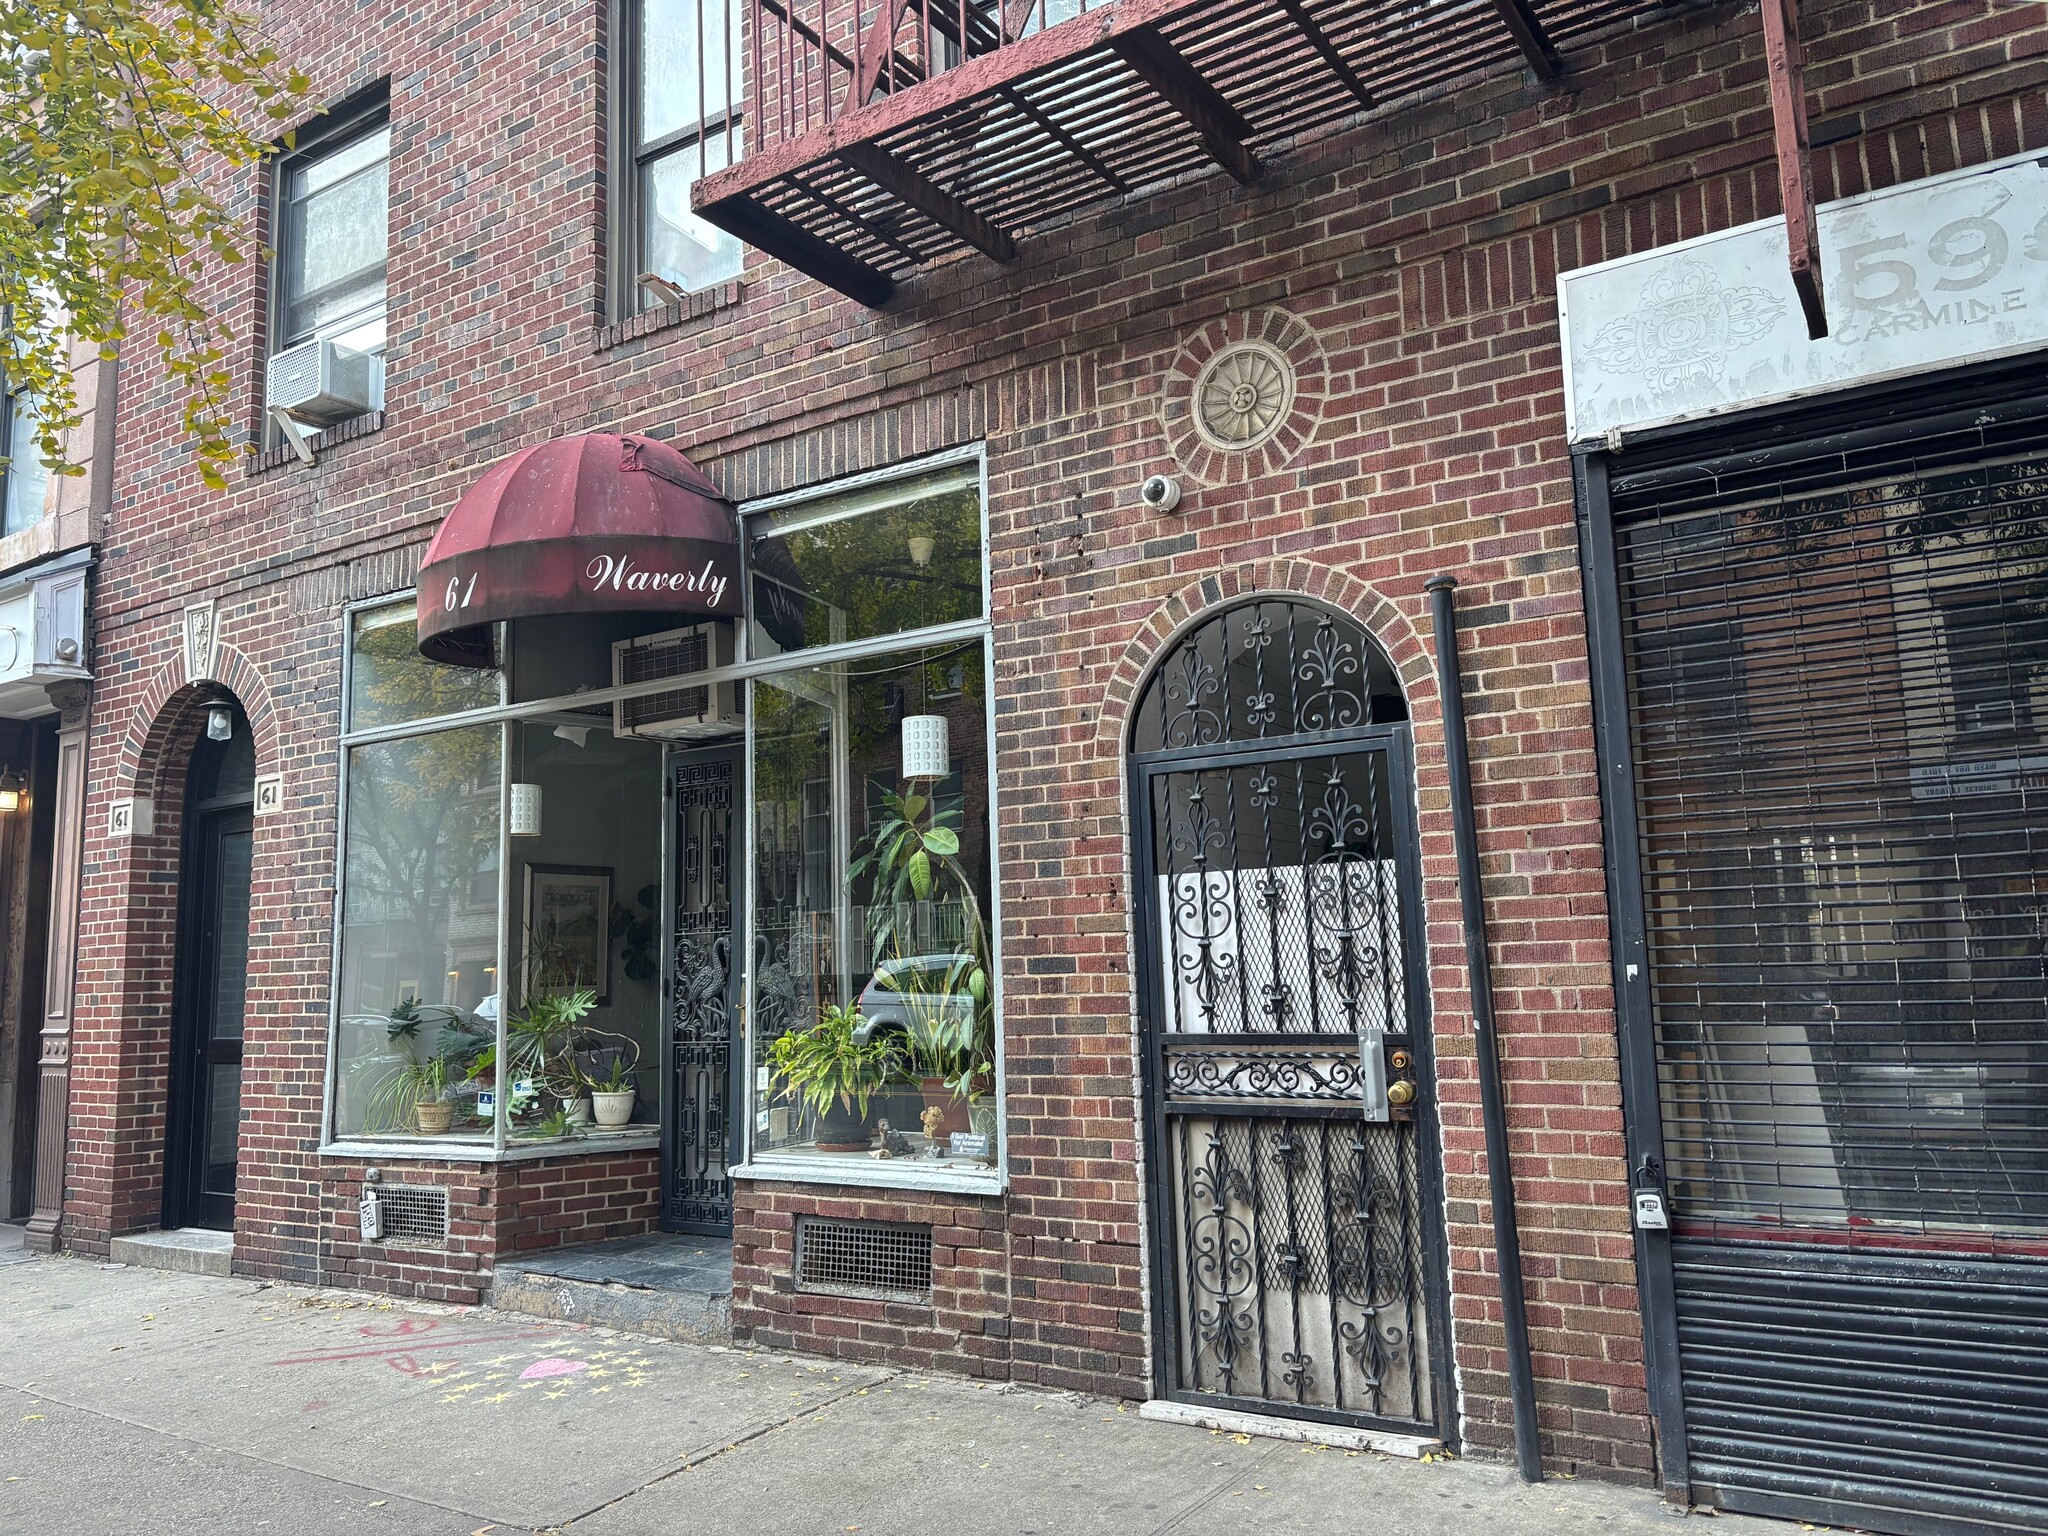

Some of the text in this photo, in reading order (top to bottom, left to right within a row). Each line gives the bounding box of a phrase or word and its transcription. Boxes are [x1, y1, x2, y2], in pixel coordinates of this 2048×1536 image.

[1836, 216, 2009, 311] 59
[1834, 287, 2028, 346] CARMINE
[445, 571, 478, 612] 61
[586, 554, 728, 608] Waverly
[115, 809, 129, 827] 61
[261, 785, 277, 805] 61
